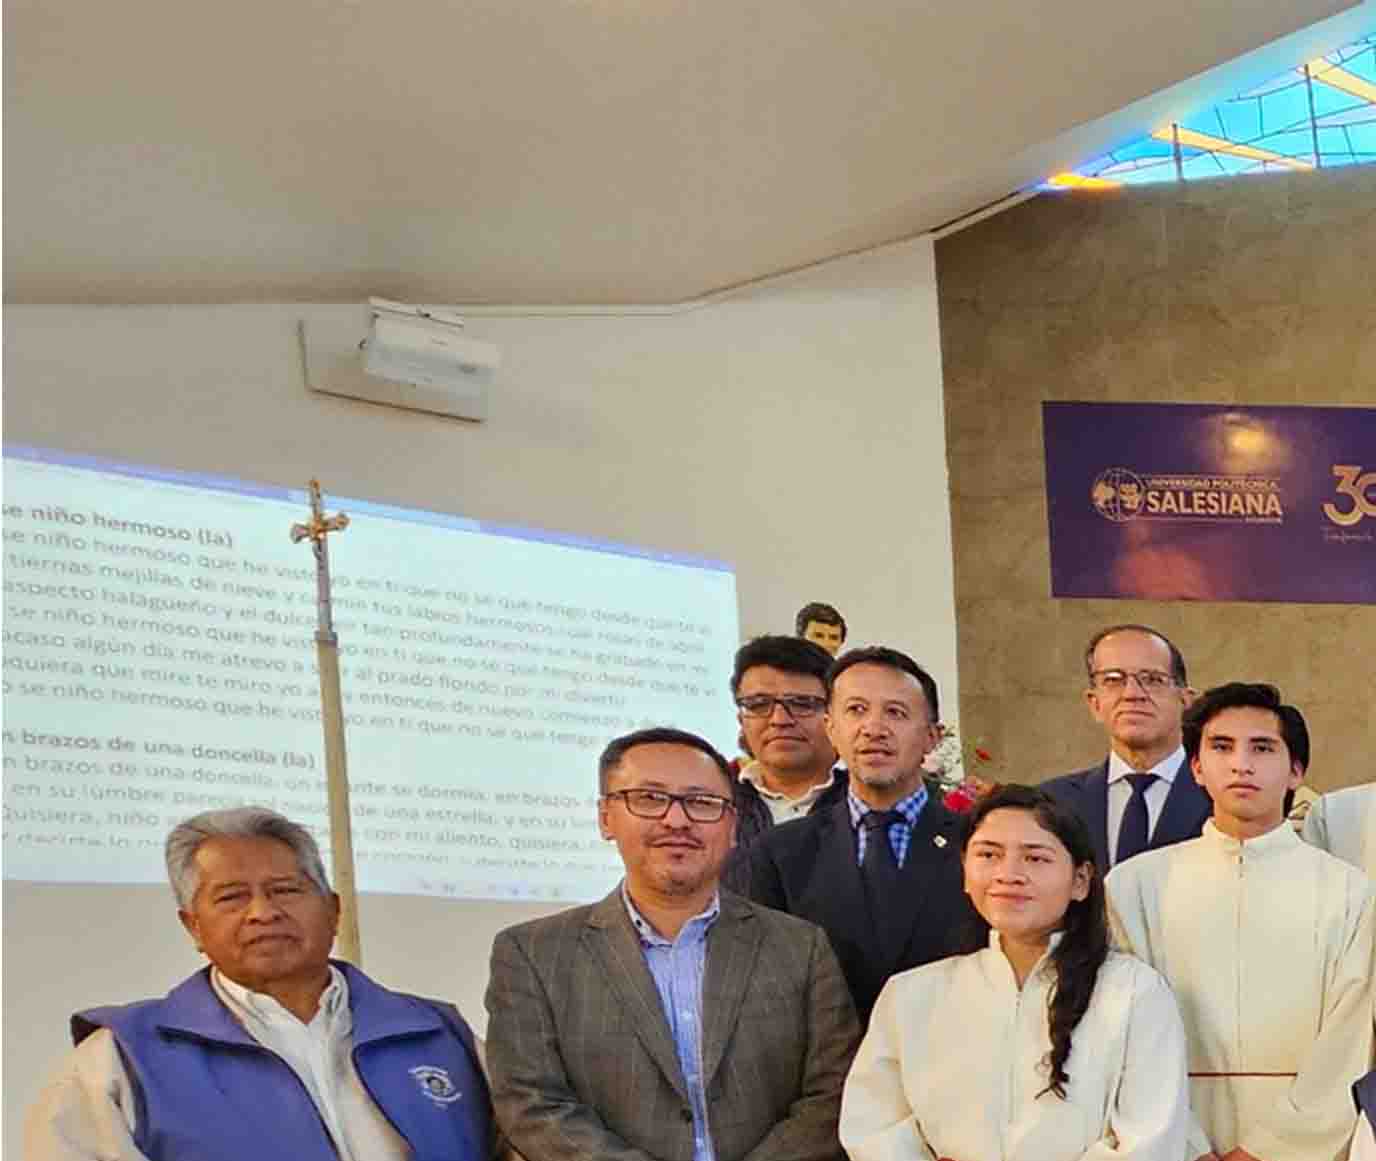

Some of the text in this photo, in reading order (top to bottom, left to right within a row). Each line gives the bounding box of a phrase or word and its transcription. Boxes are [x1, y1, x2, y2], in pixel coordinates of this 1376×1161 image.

[1146, 490, 1282, 516] SALESIANA
[31, 504, 84, 526] niño
[93, 514, 190, 540] hermoso
[198, 528, 232, 551] (la)
[9, 552, 92, 574] tiernas
[99, 564, 183, 589] mejillas
[34, 530, 85, 551] niño
[93, 539, 190, 564] hermoso
[198, 557, 236, 575] que
[243, 559, 267, 575] he
[2, 577, 94, 602] aspecto
[43, 607, 95, 625] niño
[102, 614, 200, 636] hermoso
[206, 629, 246, 645] que
[282, 635, 316, 650] vist
[377, 669, 433, 689] prado
[52, 683, 104, 701] niño
[111, 689, 206, 709] hermoso
[213, 702, 252, 718] que
[287, 706, 320, 720] vist
[21, 730, 314, 769] brazos de una doncella (la)
[25, 755, 98, 774] brazos
[109, 761, 135, 777] de
[145, 767, 185, 780] una
